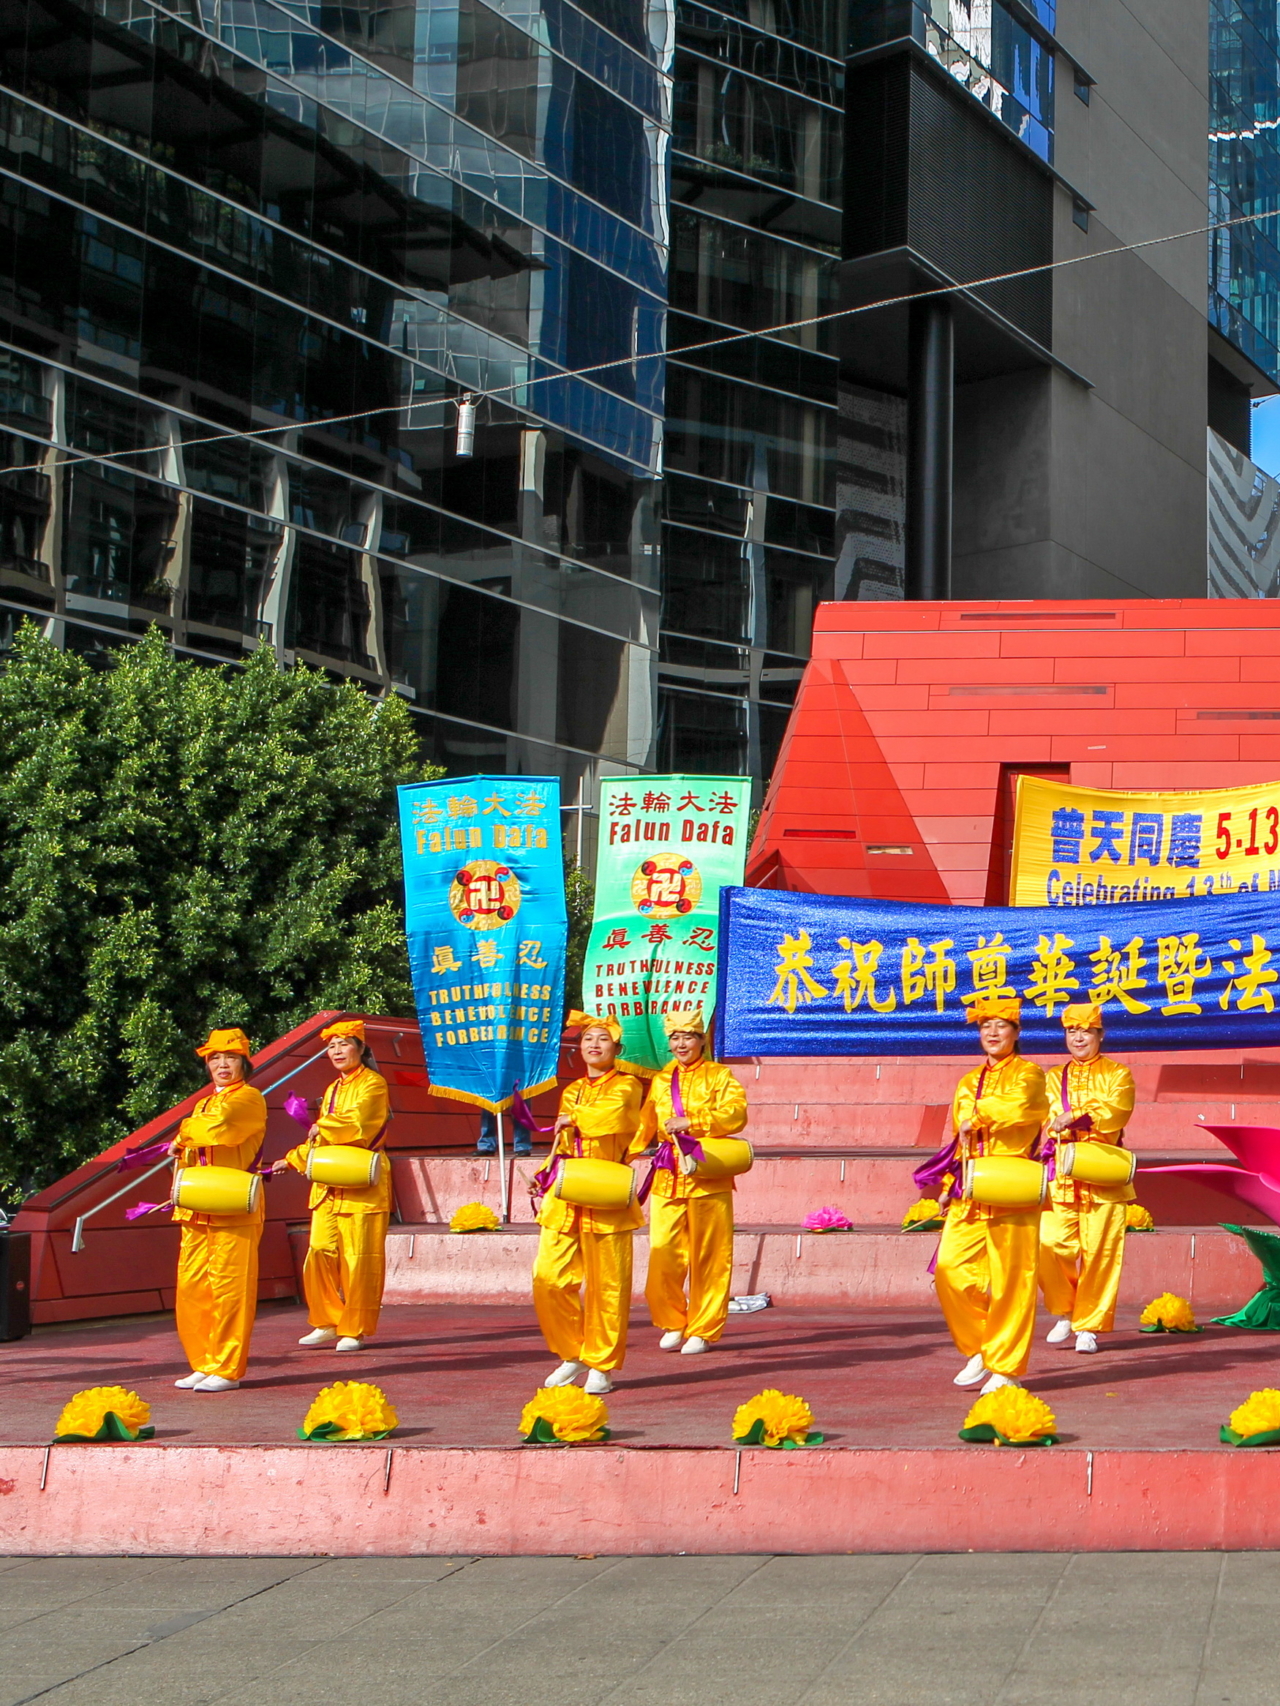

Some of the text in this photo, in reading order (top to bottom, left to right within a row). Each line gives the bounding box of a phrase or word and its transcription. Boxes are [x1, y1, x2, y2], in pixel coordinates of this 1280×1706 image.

[411, 790, 546, 825] 法輪大法
[608, 790, 738, 816] 法輪大法
[416, 824, 548, 855] Falun Dafa
[609, 819, 734, 846] Falun Dafa
[1051, 806, 1203, 868] 普天同慶
[596, 959, 715, 977] TRUTHFULNESS
[595, 980, 710, 998] BENEVLENCE
[430, 1005, 551, 1026] BENEVOLENCE
[595, 1000, 704, 1016] FORBRANCE
